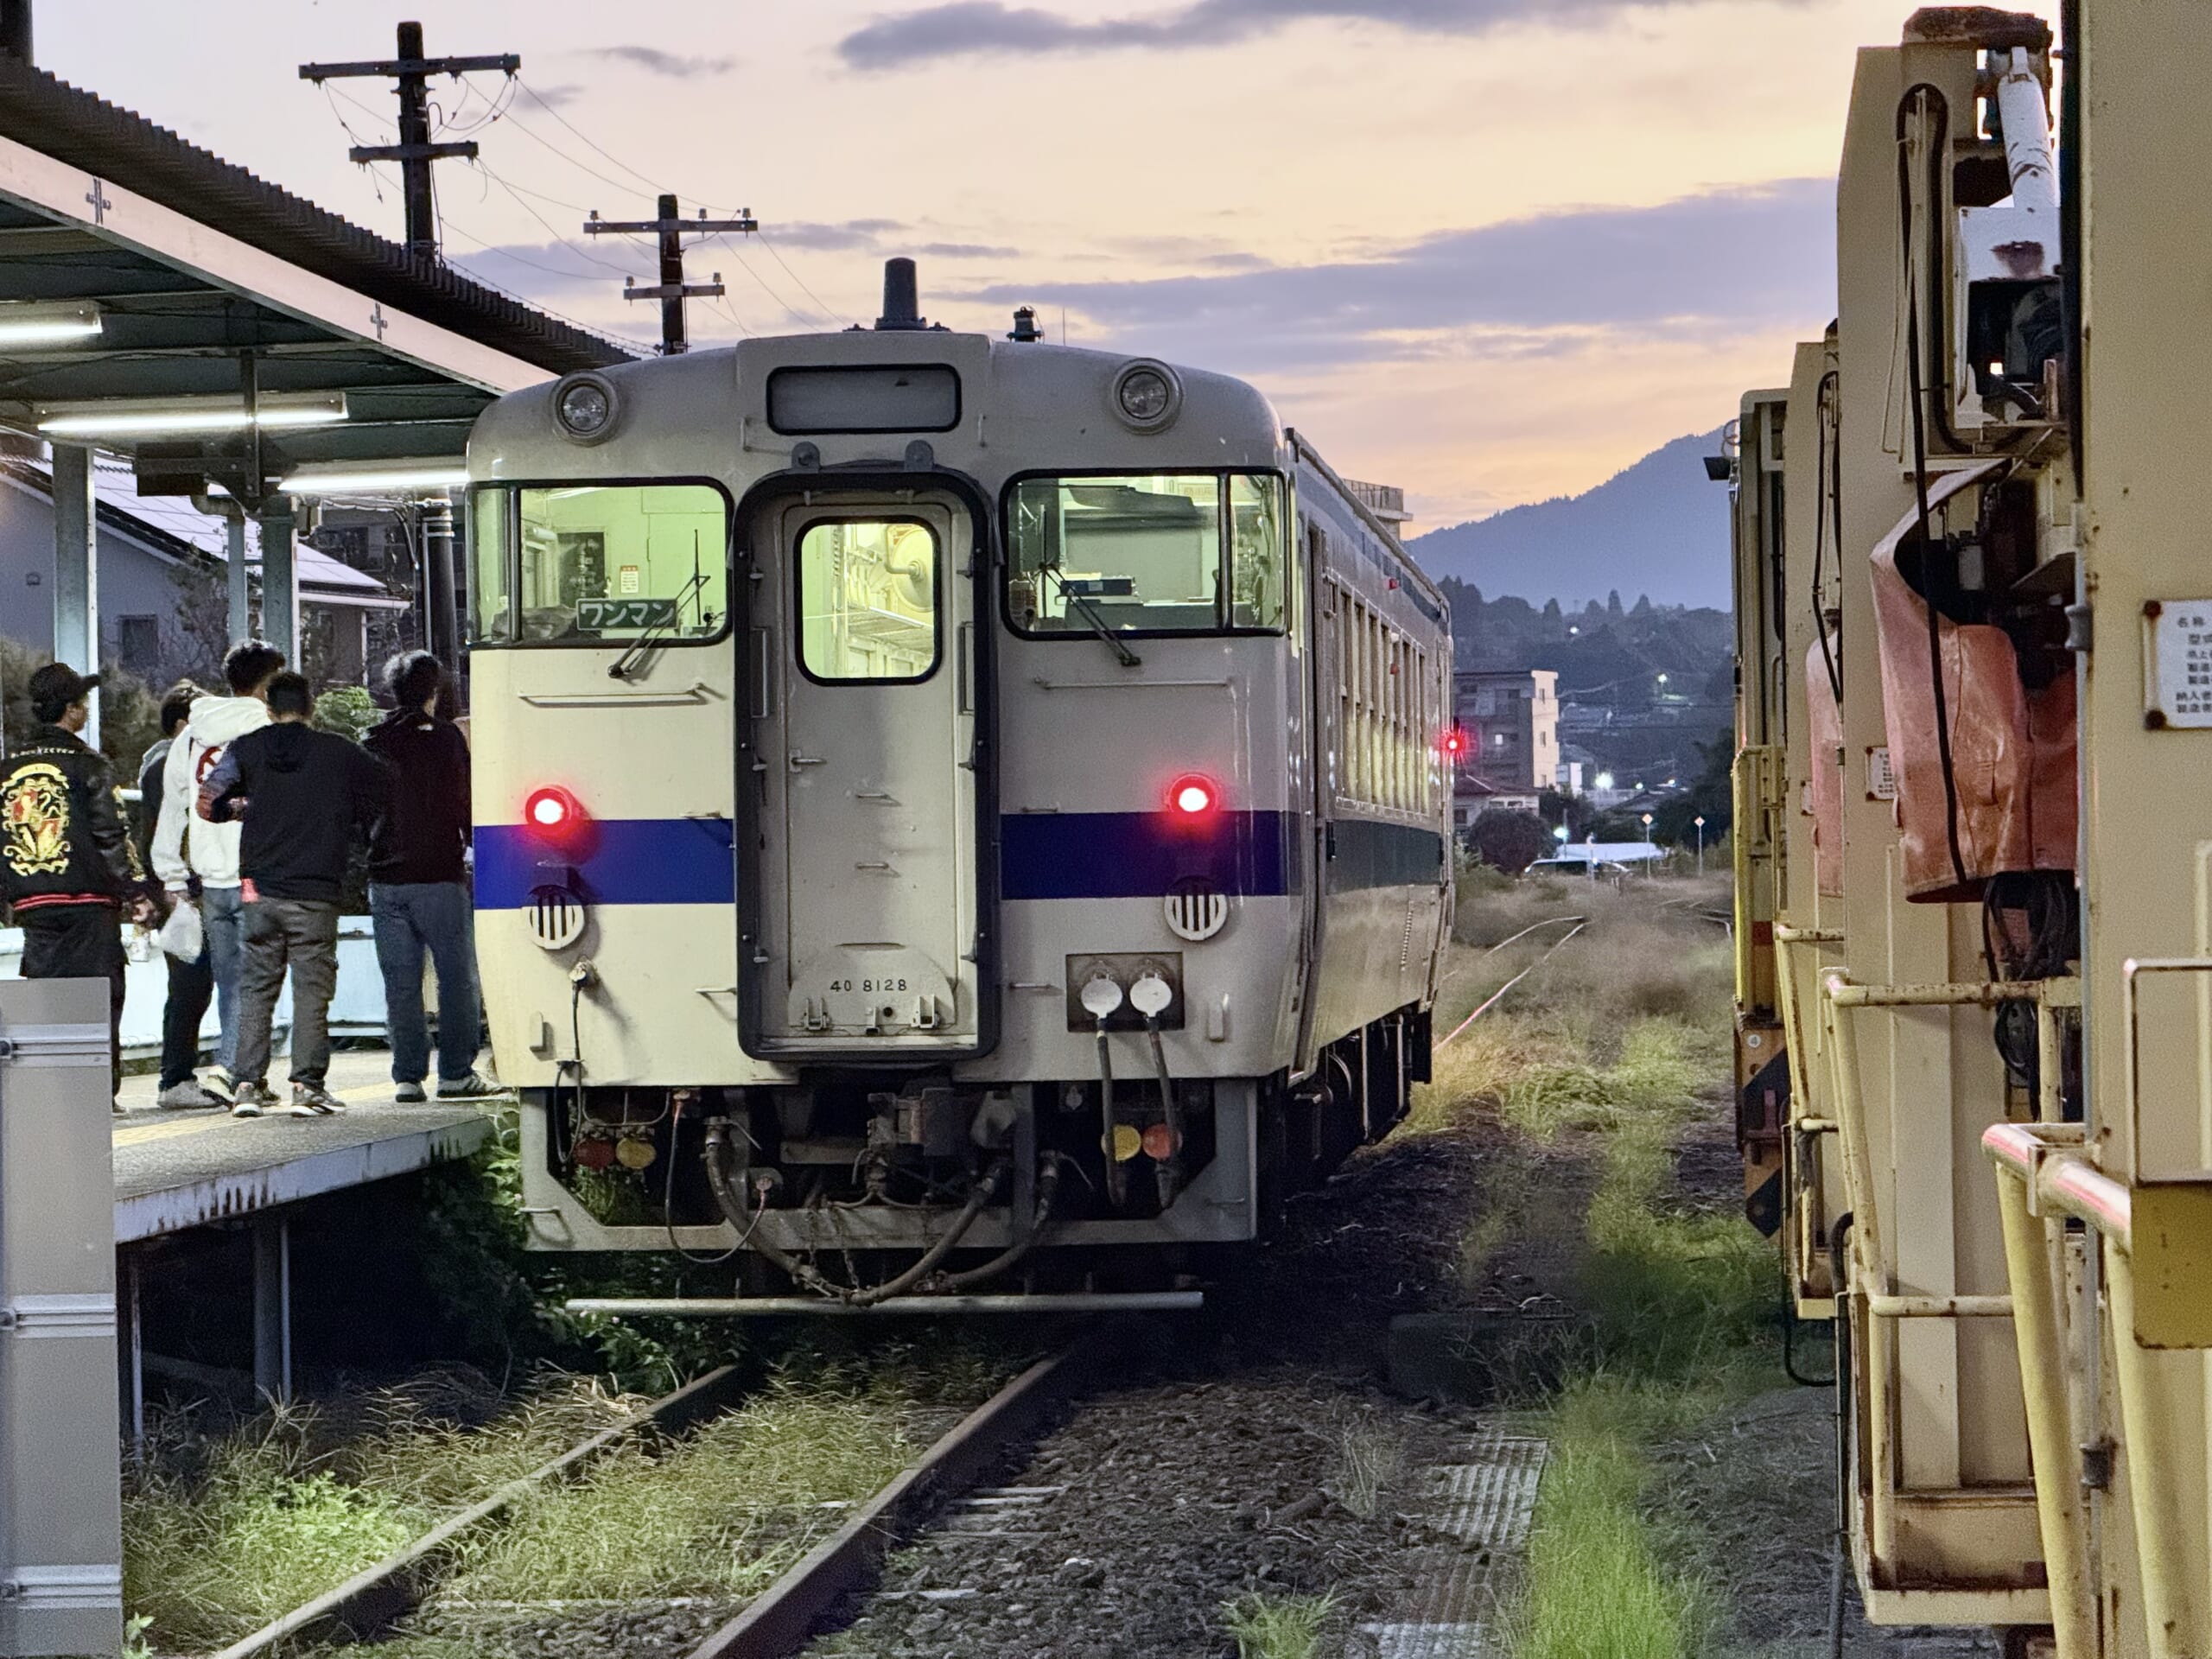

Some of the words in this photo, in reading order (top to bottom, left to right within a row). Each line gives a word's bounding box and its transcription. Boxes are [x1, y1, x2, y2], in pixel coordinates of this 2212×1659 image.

[581, 603, 674, 626] ワンマン
[830, 980, 852, 993] 40
[862, 978, 907, 992] 8128
